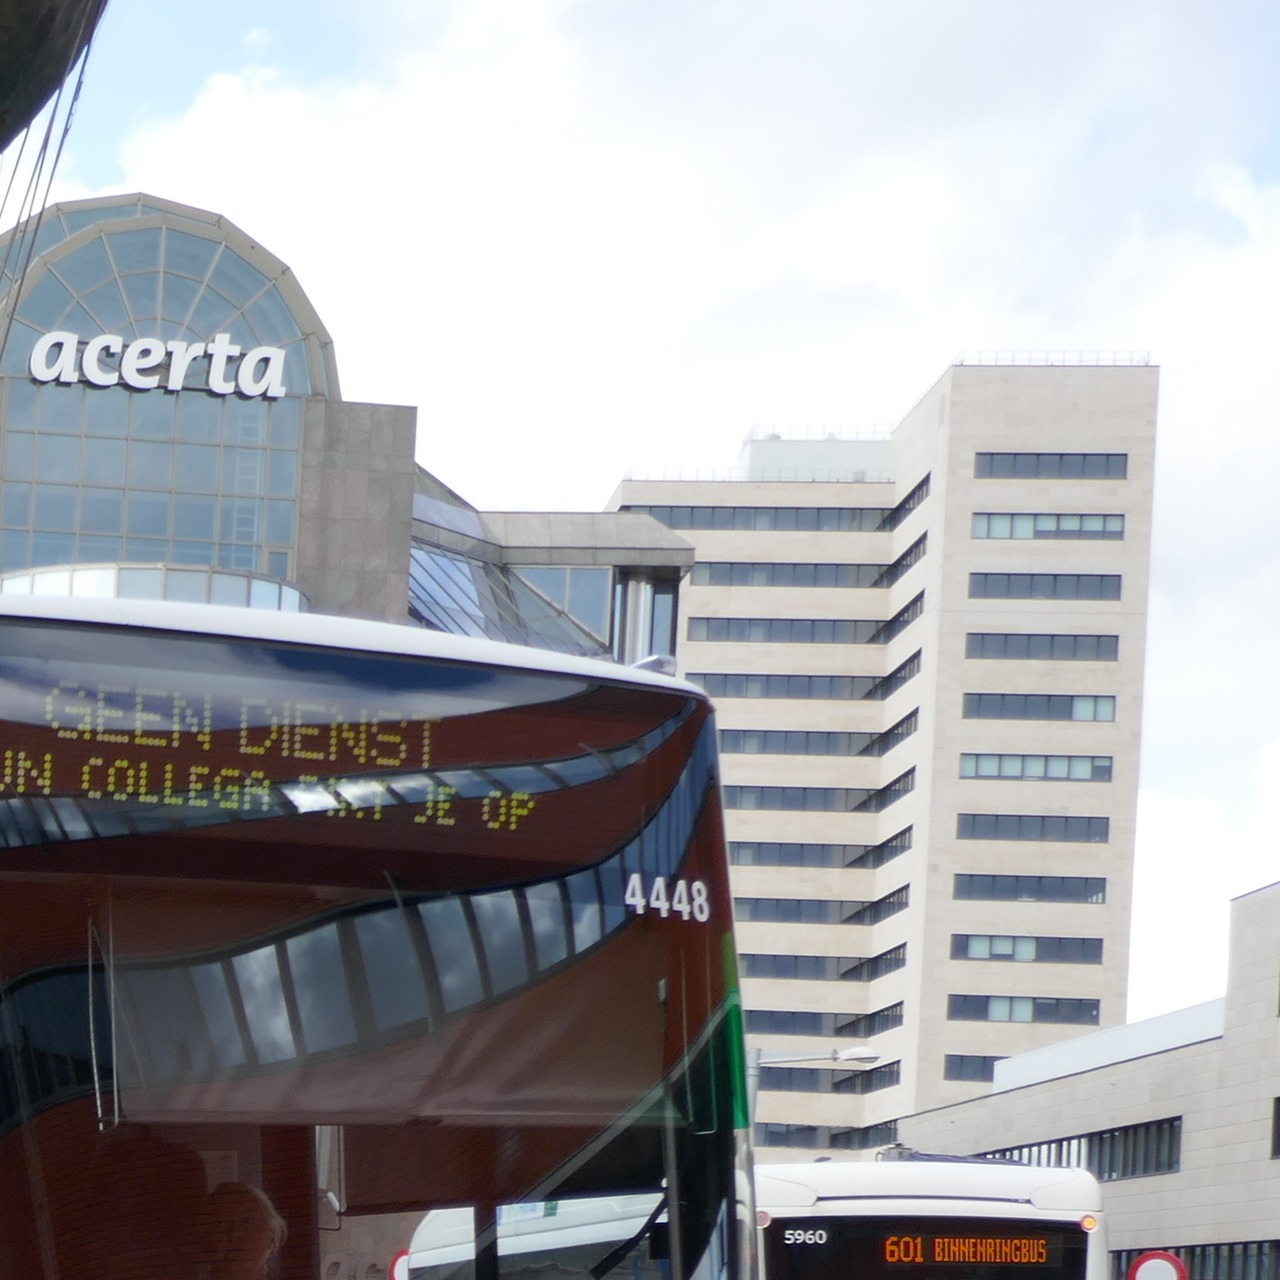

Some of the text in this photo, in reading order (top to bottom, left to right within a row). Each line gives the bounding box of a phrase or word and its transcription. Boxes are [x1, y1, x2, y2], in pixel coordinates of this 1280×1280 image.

[30, 331, 286, 398] acerta
[44, 680, 441, 770] GEEN DIENST
[81, 757, 271, 811] COLLEGA
[413, 784, 457, 827] JE
[481, 789, 536, 831] OP
[624, 873, 710, 923] 4448
[784, 1230, 828, 1245] 5960
[884, 1236, 1047, 1264] 601 BINNENRINGBUS
